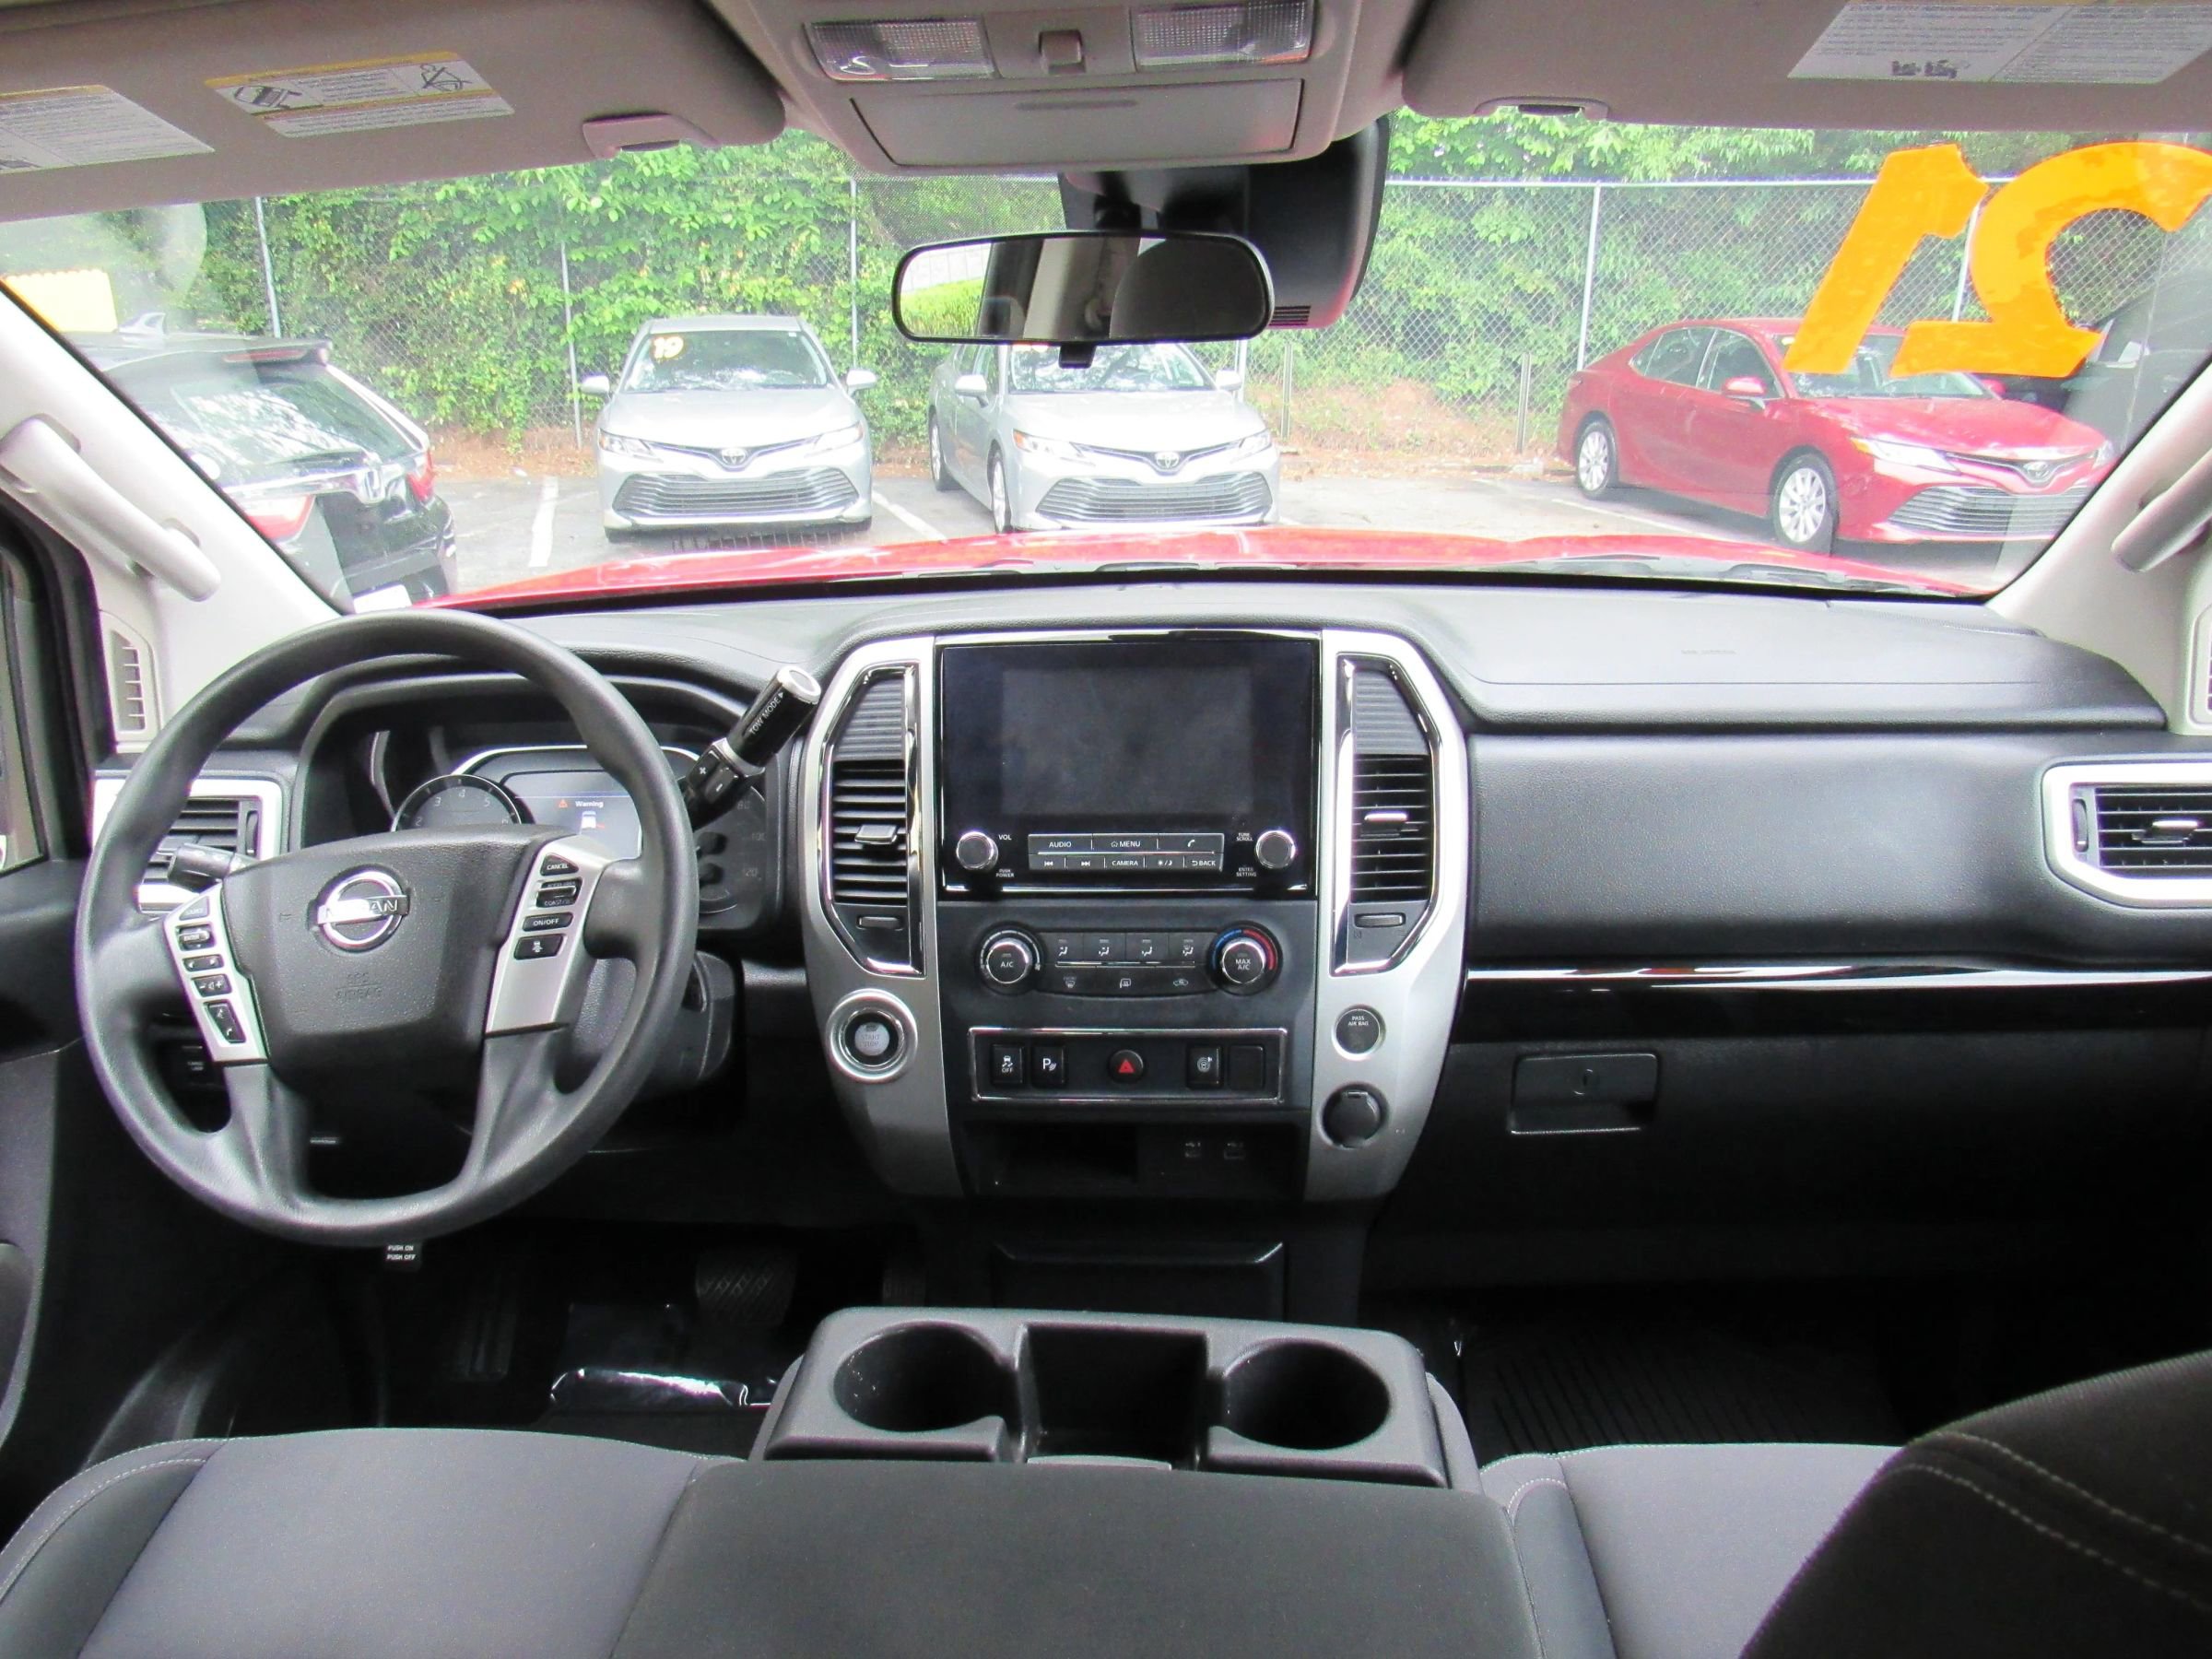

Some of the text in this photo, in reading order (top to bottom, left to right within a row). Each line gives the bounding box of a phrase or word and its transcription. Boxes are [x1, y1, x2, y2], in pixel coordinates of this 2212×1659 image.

[653, 335, 685, 359] 19
[748, 698, 782, 735] TOW MODE
[435, 797, 441, 806] 3
[484, 797, 490, 807] 5
[574, 800, 604, 808] Warning
[415, 817, 422, 827] 2
[547, 863, 569, 871] CANCEL
[533, 918, 559, 926] ON/OFF
[1042, 1058, 1052, 1070] P
